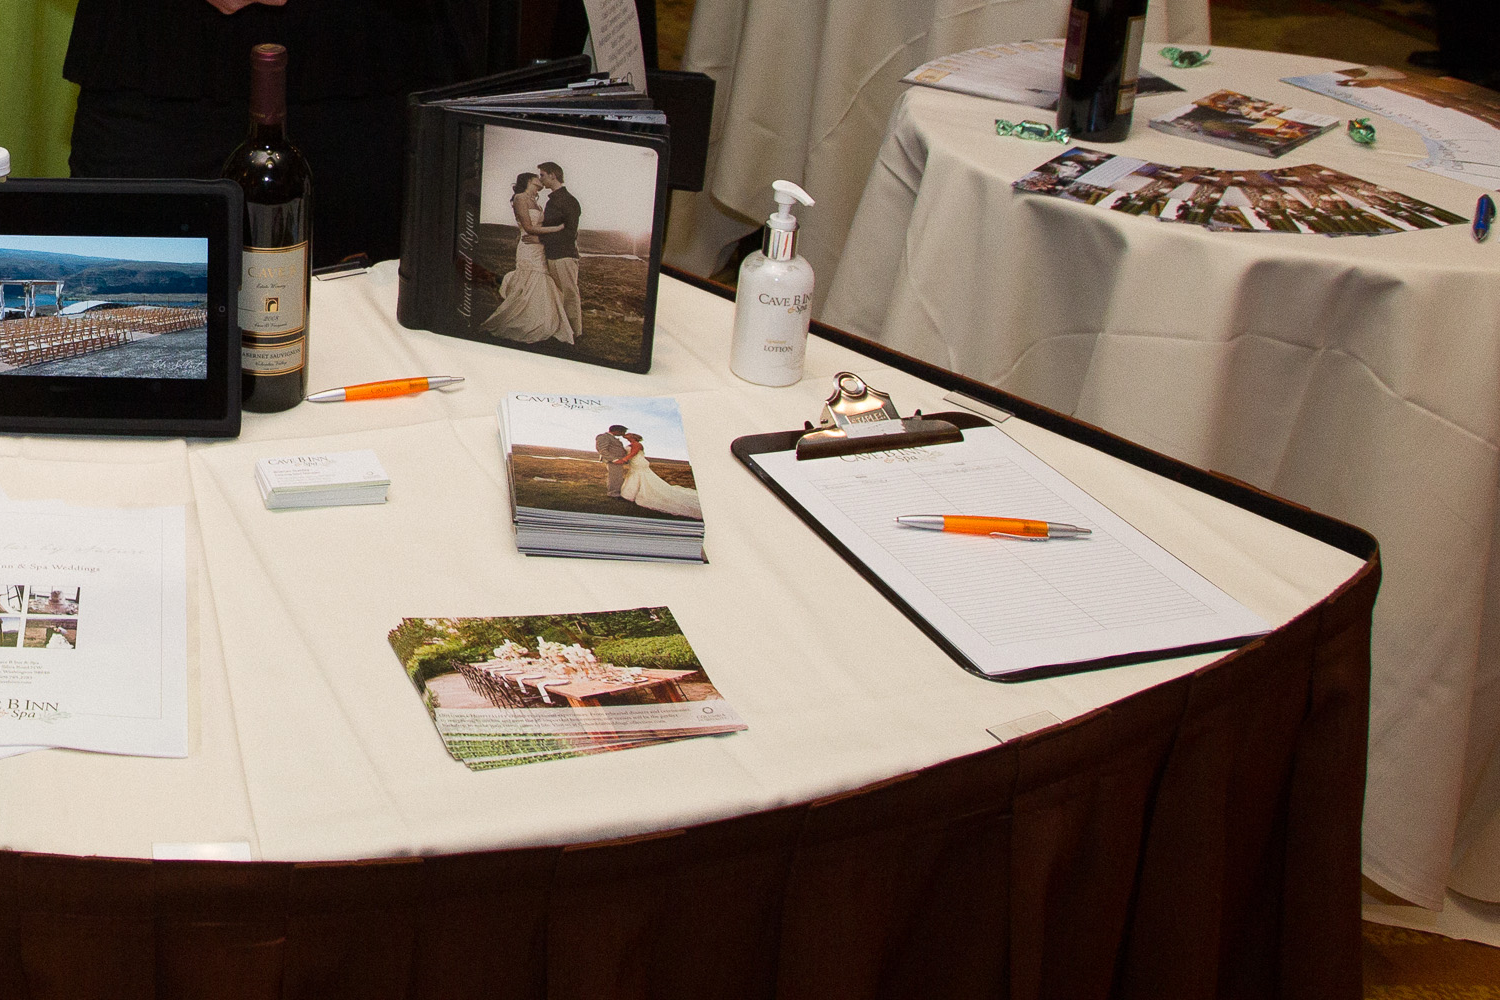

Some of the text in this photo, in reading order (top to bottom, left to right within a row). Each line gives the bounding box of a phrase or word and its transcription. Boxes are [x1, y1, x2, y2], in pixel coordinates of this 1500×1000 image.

[459, 210, 478, 251] Ryan
[459, 249, 473, 280] and
[247, 266, 286, 279] CAVE
[758, 292, 813, 307] CAVE B IN
[241, 347, 301, 360] ABERNET SAUVIGNON
[763, 345, 793, 353] LOTION
[515, 394, 601, 406] CAVE B INN
[564, 402, 584, 410] Spa
[850, 411, 886, 424] STAPLES
[308, 455, 328, 463] INN
[898, 455, 918, 463] Spa
[30, 563, 48, 571] Spa
[51, 564, 100, 572] Weddings
[8, 698, 19, 710] B
[26, 699, 59, 712] INN
[11, 709, 36, 720] Spa
